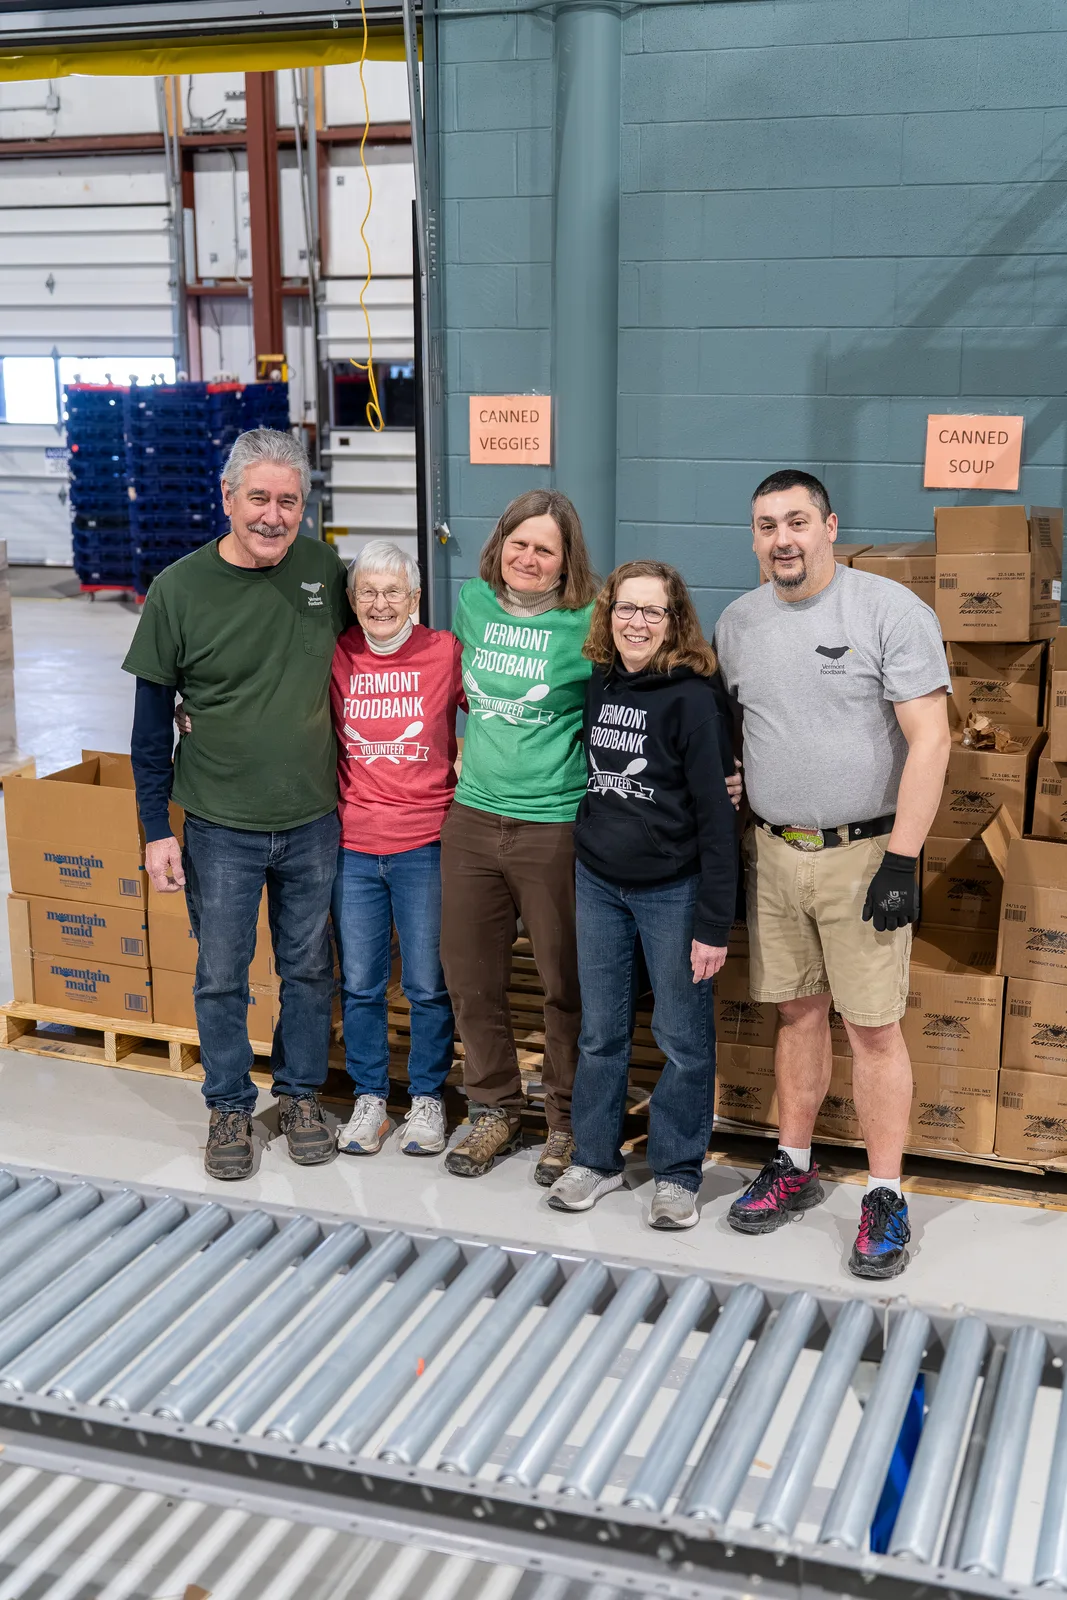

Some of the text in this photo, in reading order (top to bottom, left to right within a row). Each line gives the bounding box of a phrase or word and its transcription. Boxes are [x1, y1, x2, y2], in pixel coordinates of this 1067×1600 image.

[480, 410, 540, 423] CANNED
[479, 437, 540, 450] VEGGIES
[939, 430, 1008, 445] CANNED
[949, 459, 994, 474] SOUP
[483, 622, 553, 652] VERMONT
[471, 647, 549, 680] FOODBANK
[350, 672, 421, 694] VERMONT
[343, 696, 424, 719] FOODBANK
[478, 698, 524, 717] VOLUNTEER
[598, 704, 647, 730] VERMONT
[590, 726, 648, 754] FOODBANK
[360, 743, 404, 755] VOLUNTEER
[44, 852, 104, 869] mountain
[59, 866, 92, 879] maid
[46, 910, 107, 928] mountain
[61, 924, 93, 938] maid
[1047, 928, 1067, 937] VALL
[50, 965, 111, 983] mountain
[65, 980, 97, 993] maid
[942, 1013, 970, 1021] VALLEY
[937, 1104, 966, 1112] VALLEY
[1044, 1116, 1067, 1124] VALLE
